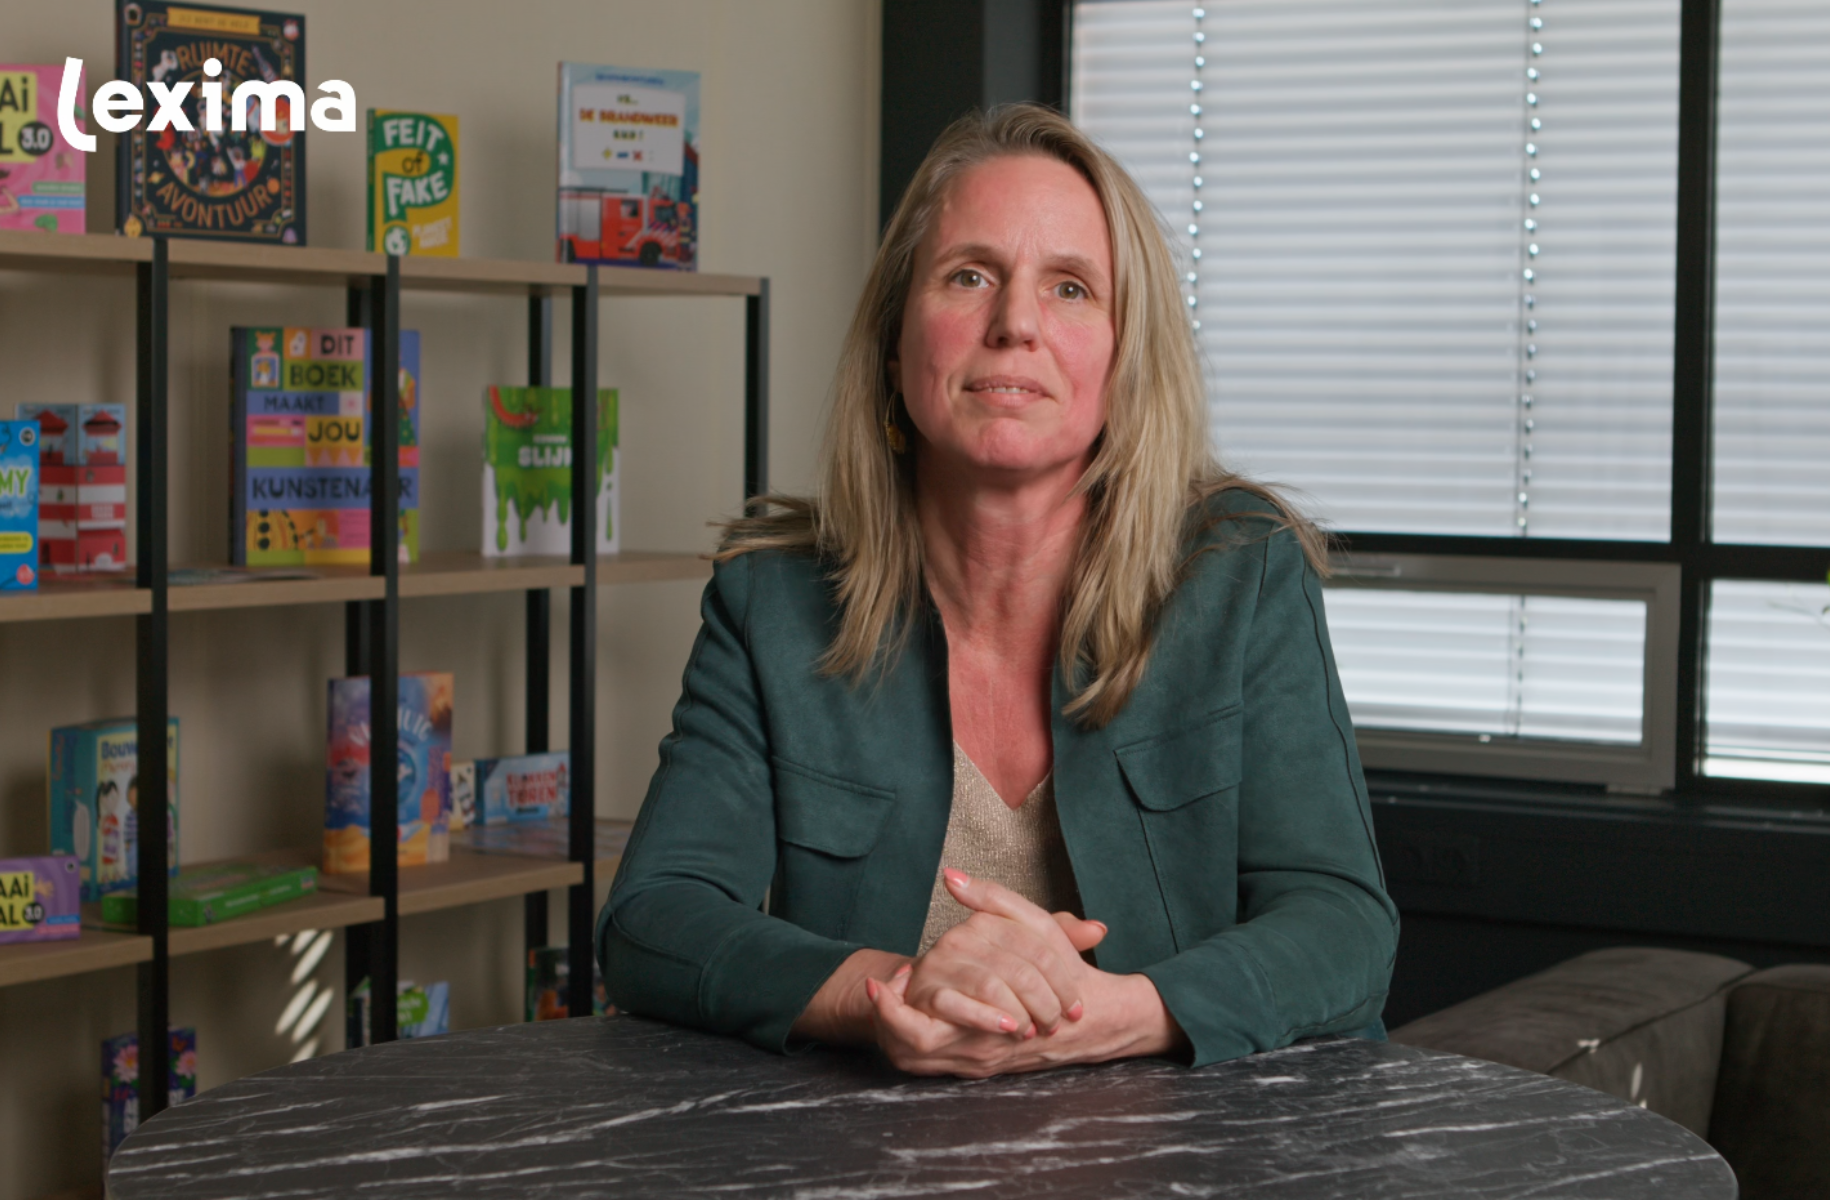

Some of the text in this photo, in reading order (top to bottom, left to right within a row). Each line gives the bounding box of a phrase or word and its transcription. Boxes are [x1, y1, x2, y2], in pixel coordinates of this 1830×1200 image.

[21, 128, 51, 150] 3.0
[383, 118, 444, 153] FEIT
[402, 150, 425, 174] of
[386, 171, 449, 217] FAKE
[156, 181, 273, 230] AVONTUUR
[321, 335, 355, 355] DIT
[290, 365, 357, 387] BOEK
[264, 395, 326, 412] MAAKT
[308, 421, 361, 443] JOU
